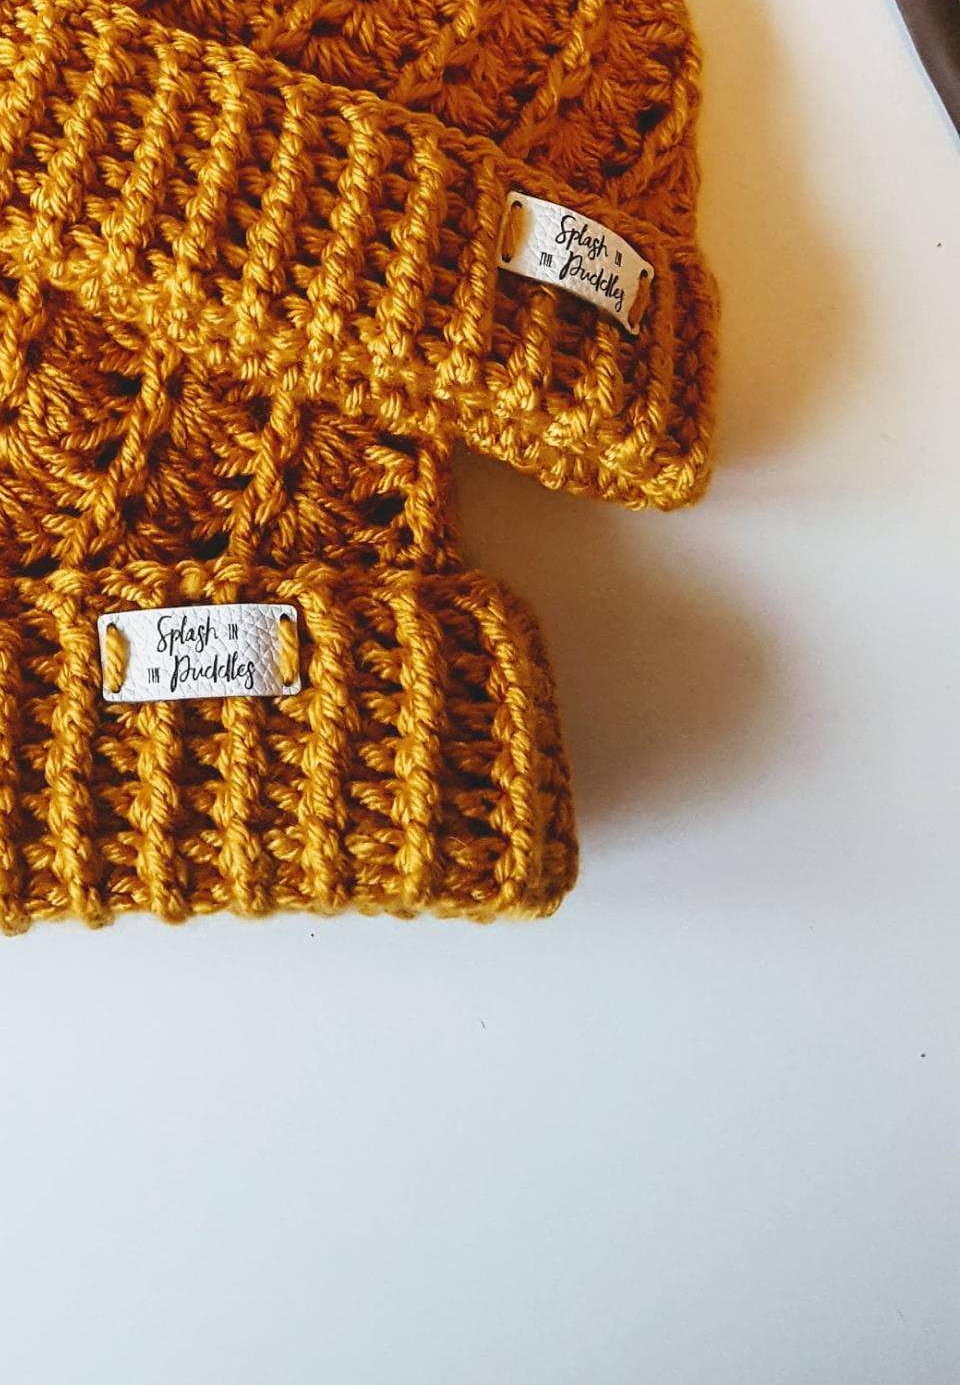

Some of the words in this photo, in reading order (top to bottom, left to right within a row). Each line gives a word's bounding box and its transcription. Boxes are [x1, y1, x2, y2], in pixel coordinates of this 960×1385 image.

[554, 215, 609, 261] Splash
[558, 251, 625, 313] Puddles
[156, 615, 219, 657] Splash
[228, 623, 239, 641] IN
[169, 650, 256, 693] Puddles
